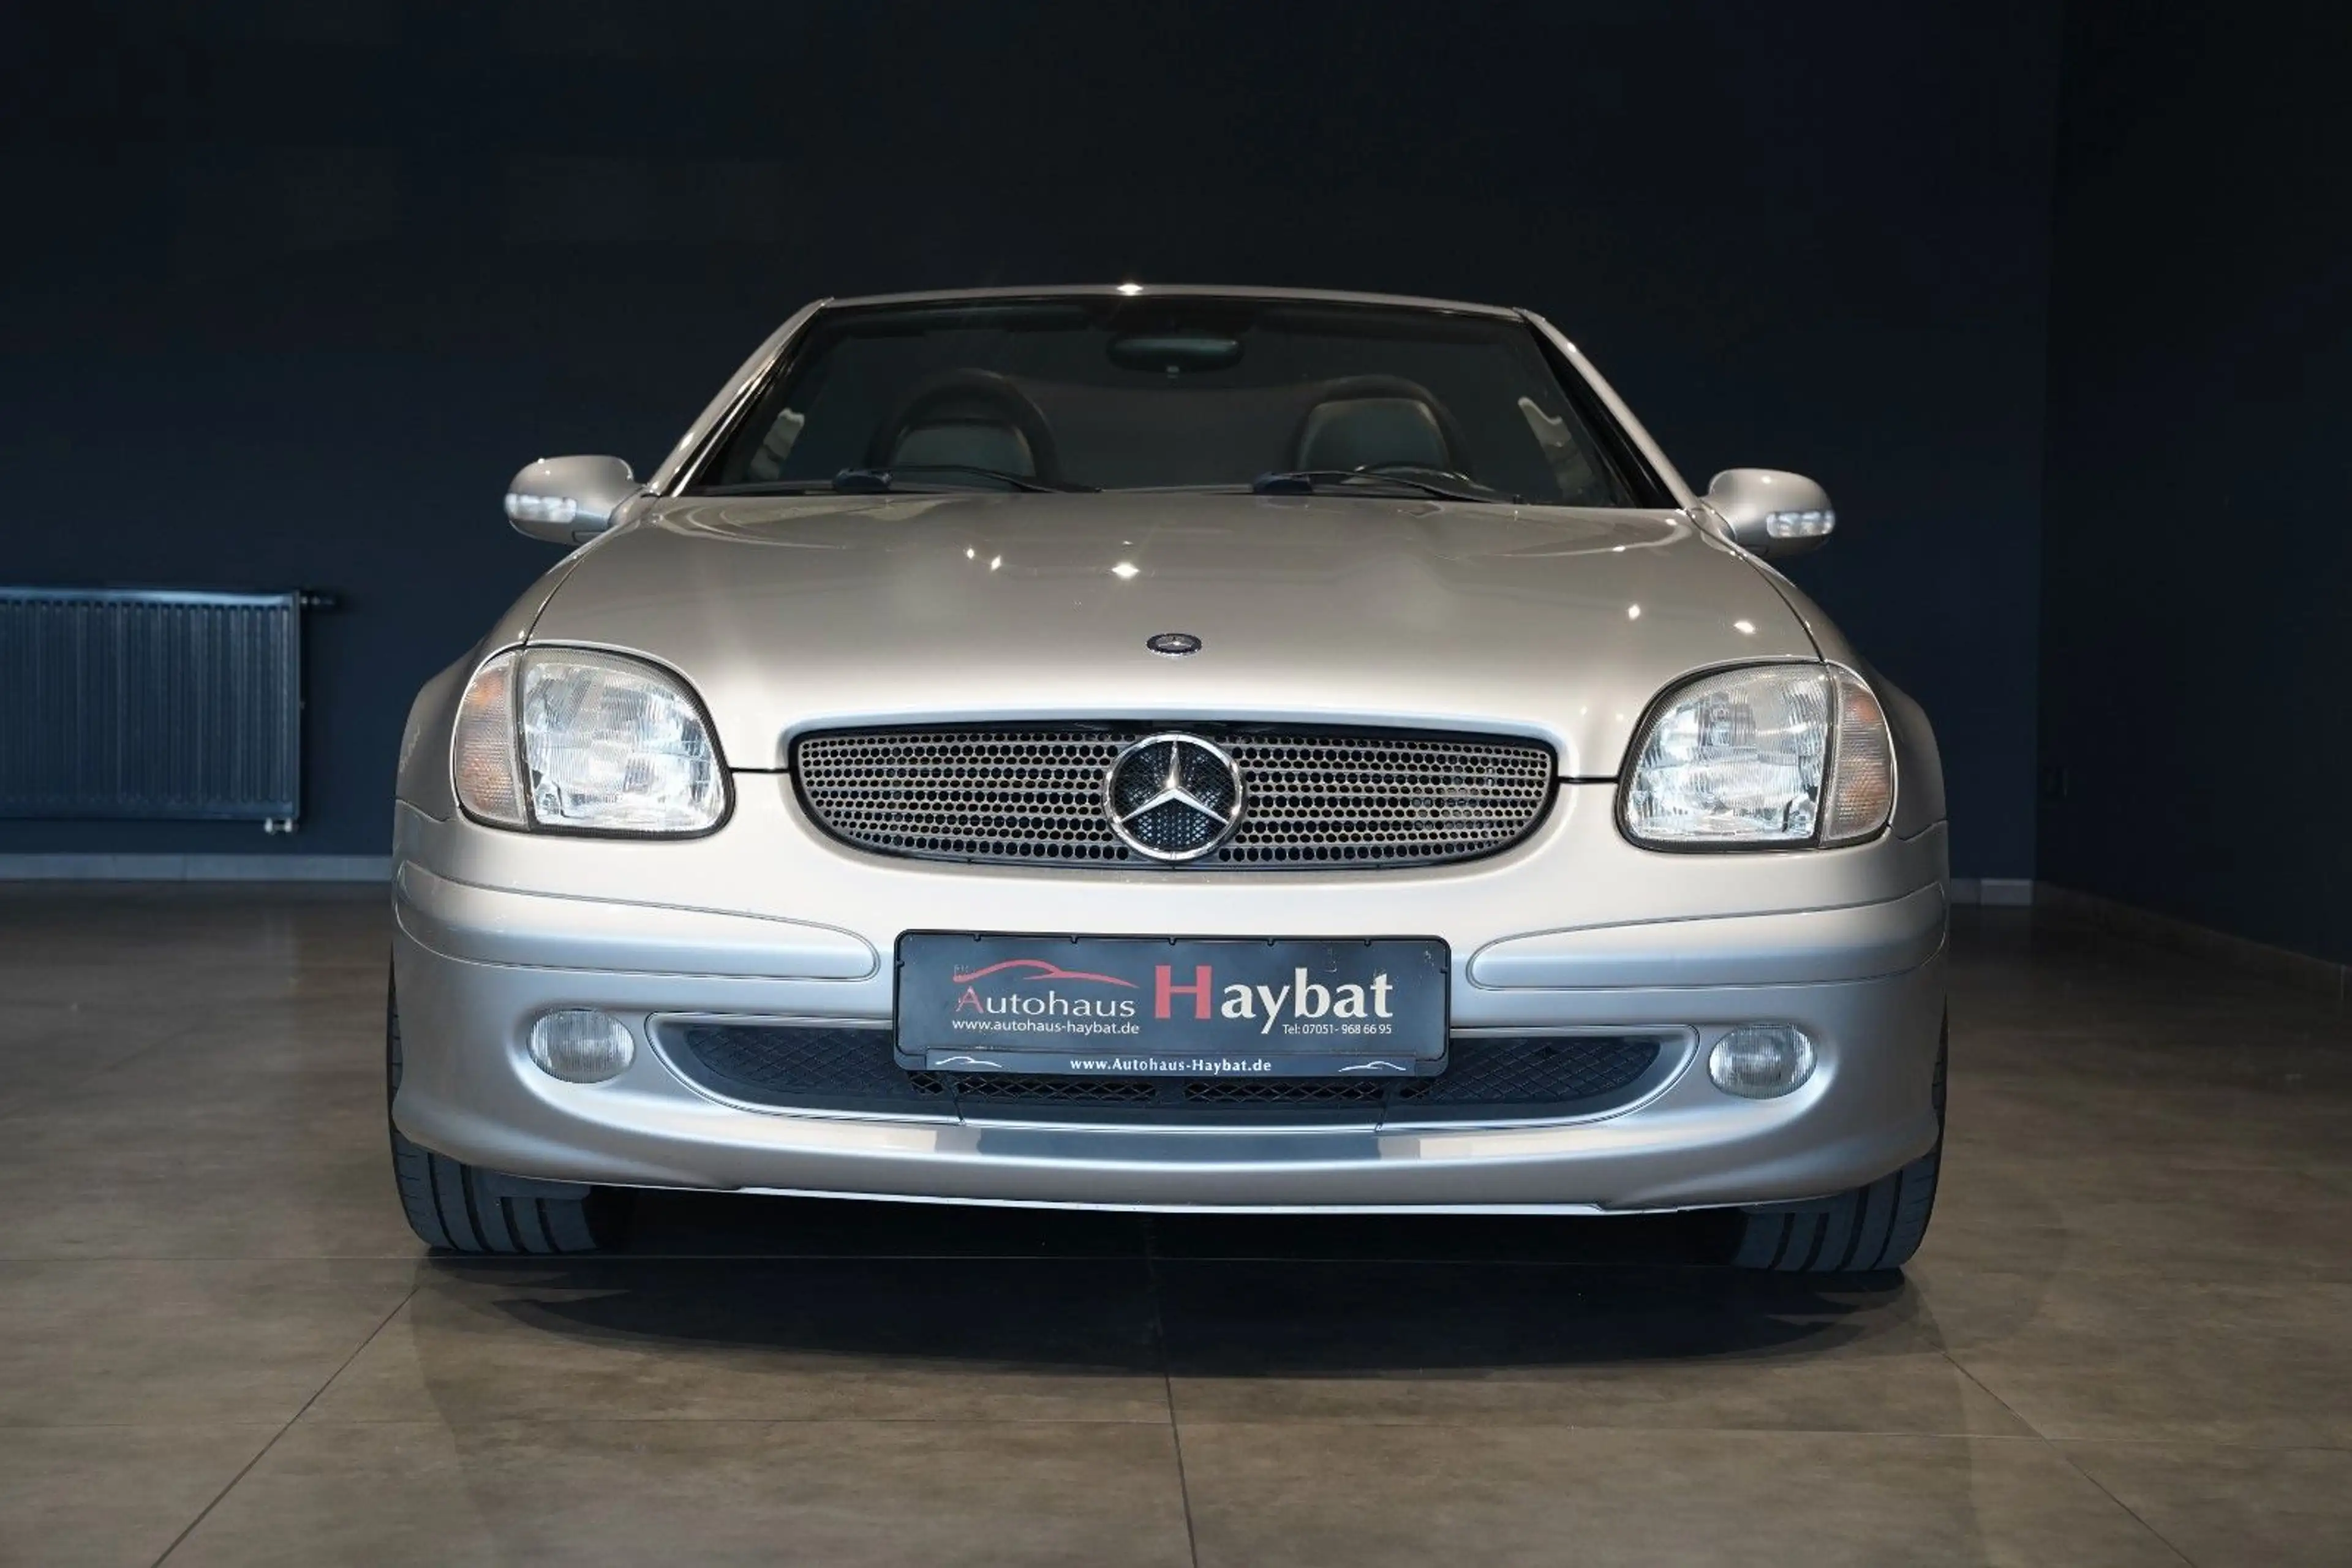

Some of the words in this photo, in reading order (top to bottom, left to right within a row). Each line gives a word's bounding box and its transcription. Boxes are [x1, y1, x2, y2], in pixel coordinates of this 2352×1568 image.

[956, 985, 1136, 1017] Autohaus
[1155, 965, 1393, 1035] Haybat
[952, 1020, 1140, 1035] www.autohaus-haybat.de
[1283, 1023, 1300, 1035] Tel:
[1302, 1023, 1338, 1035] 07051-
[1341, 1023, 1361, 1034] 968
[1363, 1023, 1377, 1034] 66
[1379, 1023, 1392, 1034] 95
[1070, 1058, 1272, 1075] www.Autohaus-Haybat.de
